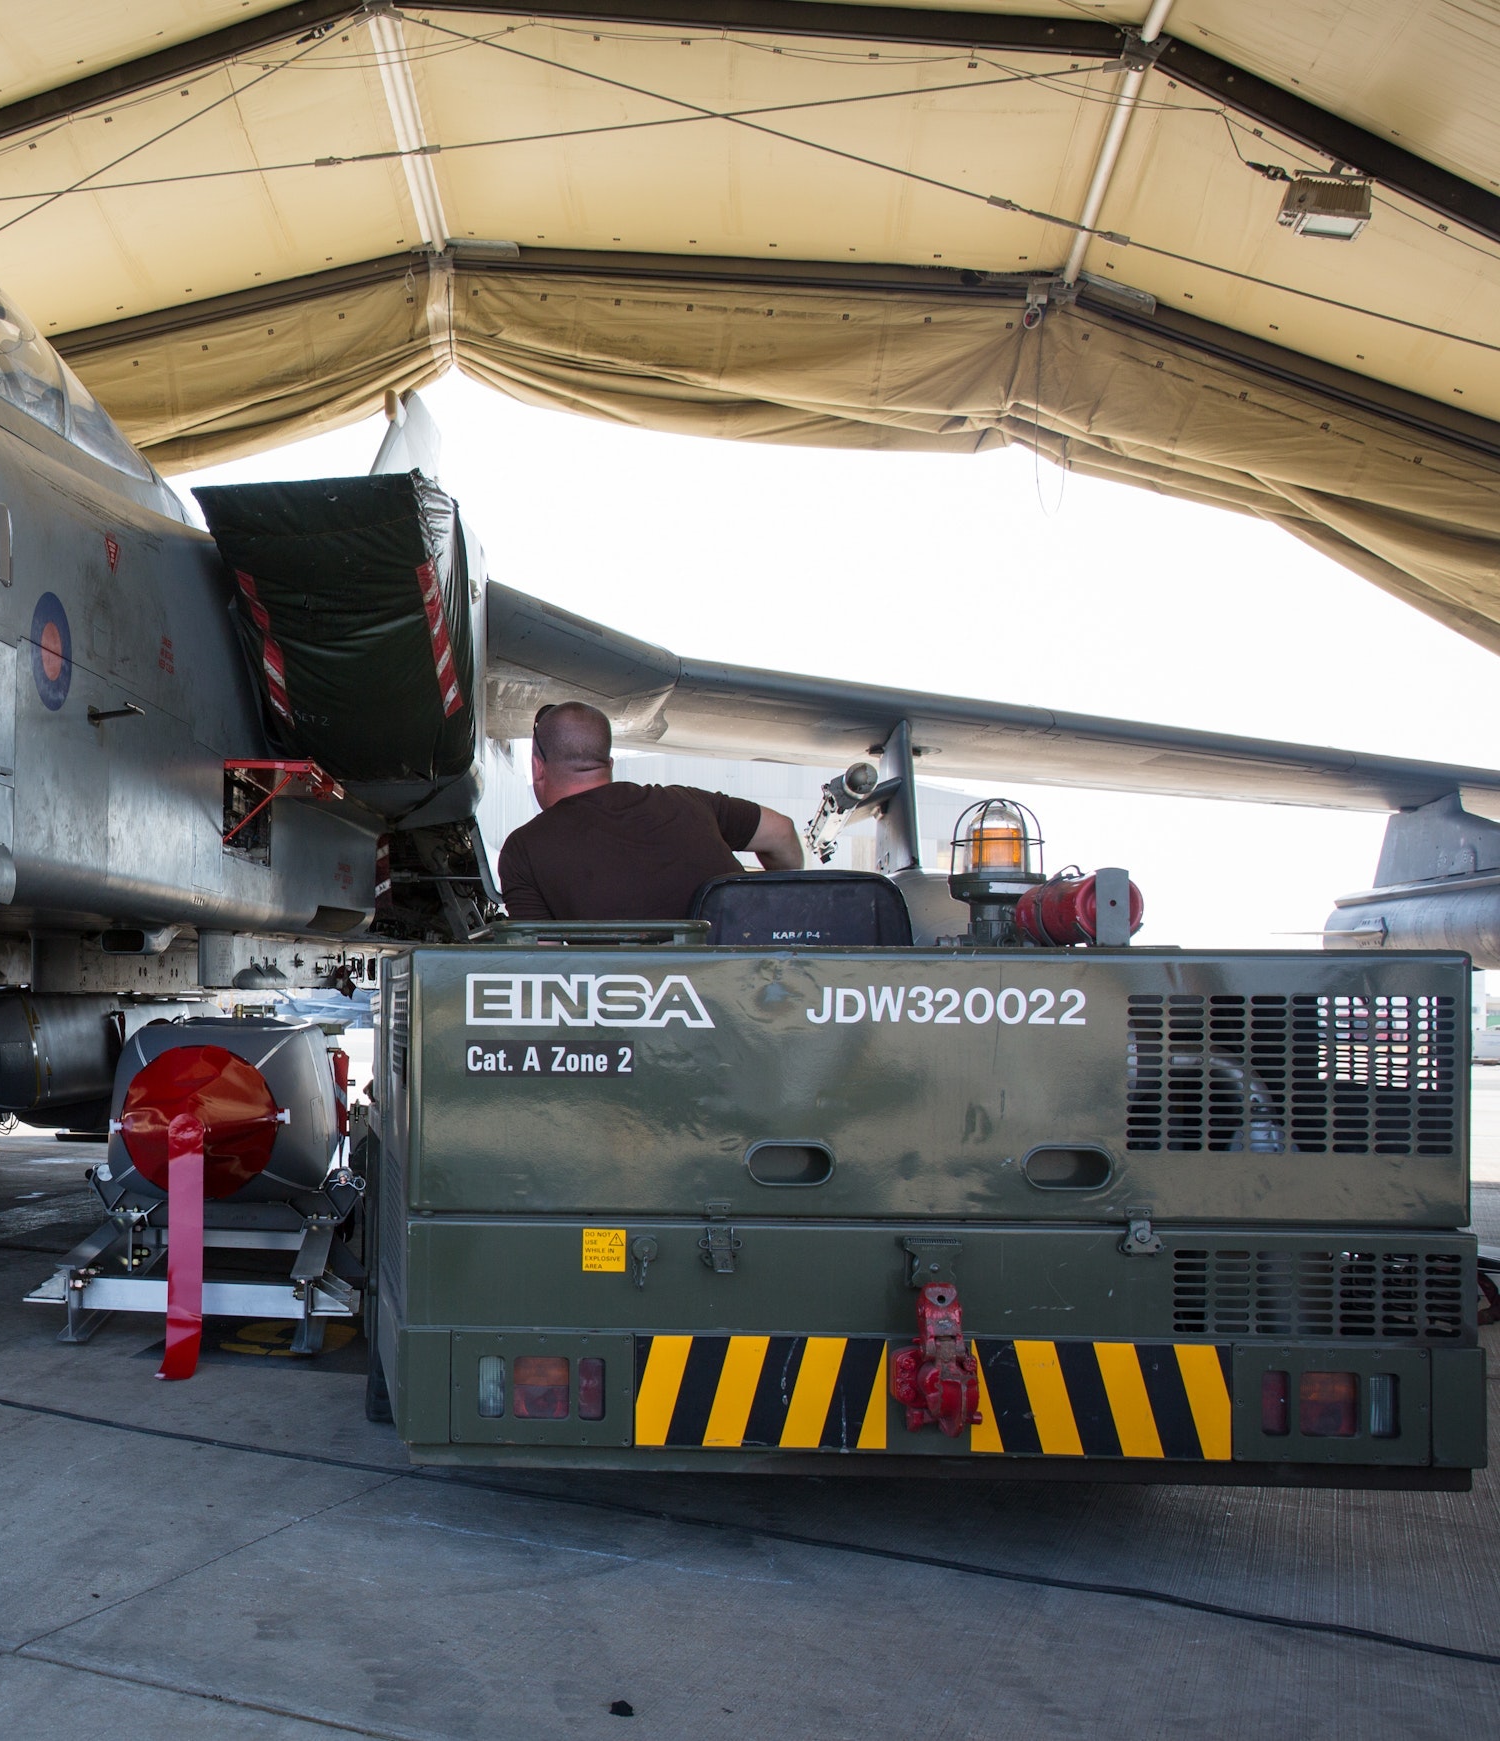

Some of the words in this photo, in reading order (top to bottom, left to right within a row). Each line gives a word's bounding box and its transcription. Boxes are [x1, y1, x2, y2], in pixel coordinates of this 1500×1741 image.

[465, 973, 716, 1029] EINSA
[806, 986, 1087, 1025] JDW320022
[467, 1046, 513, 1073] Cat.
[522, 1047, 541, 1073] A
[551, 1046, 609, 1073] Zone
[616, 1047, 632, 1073] 2
